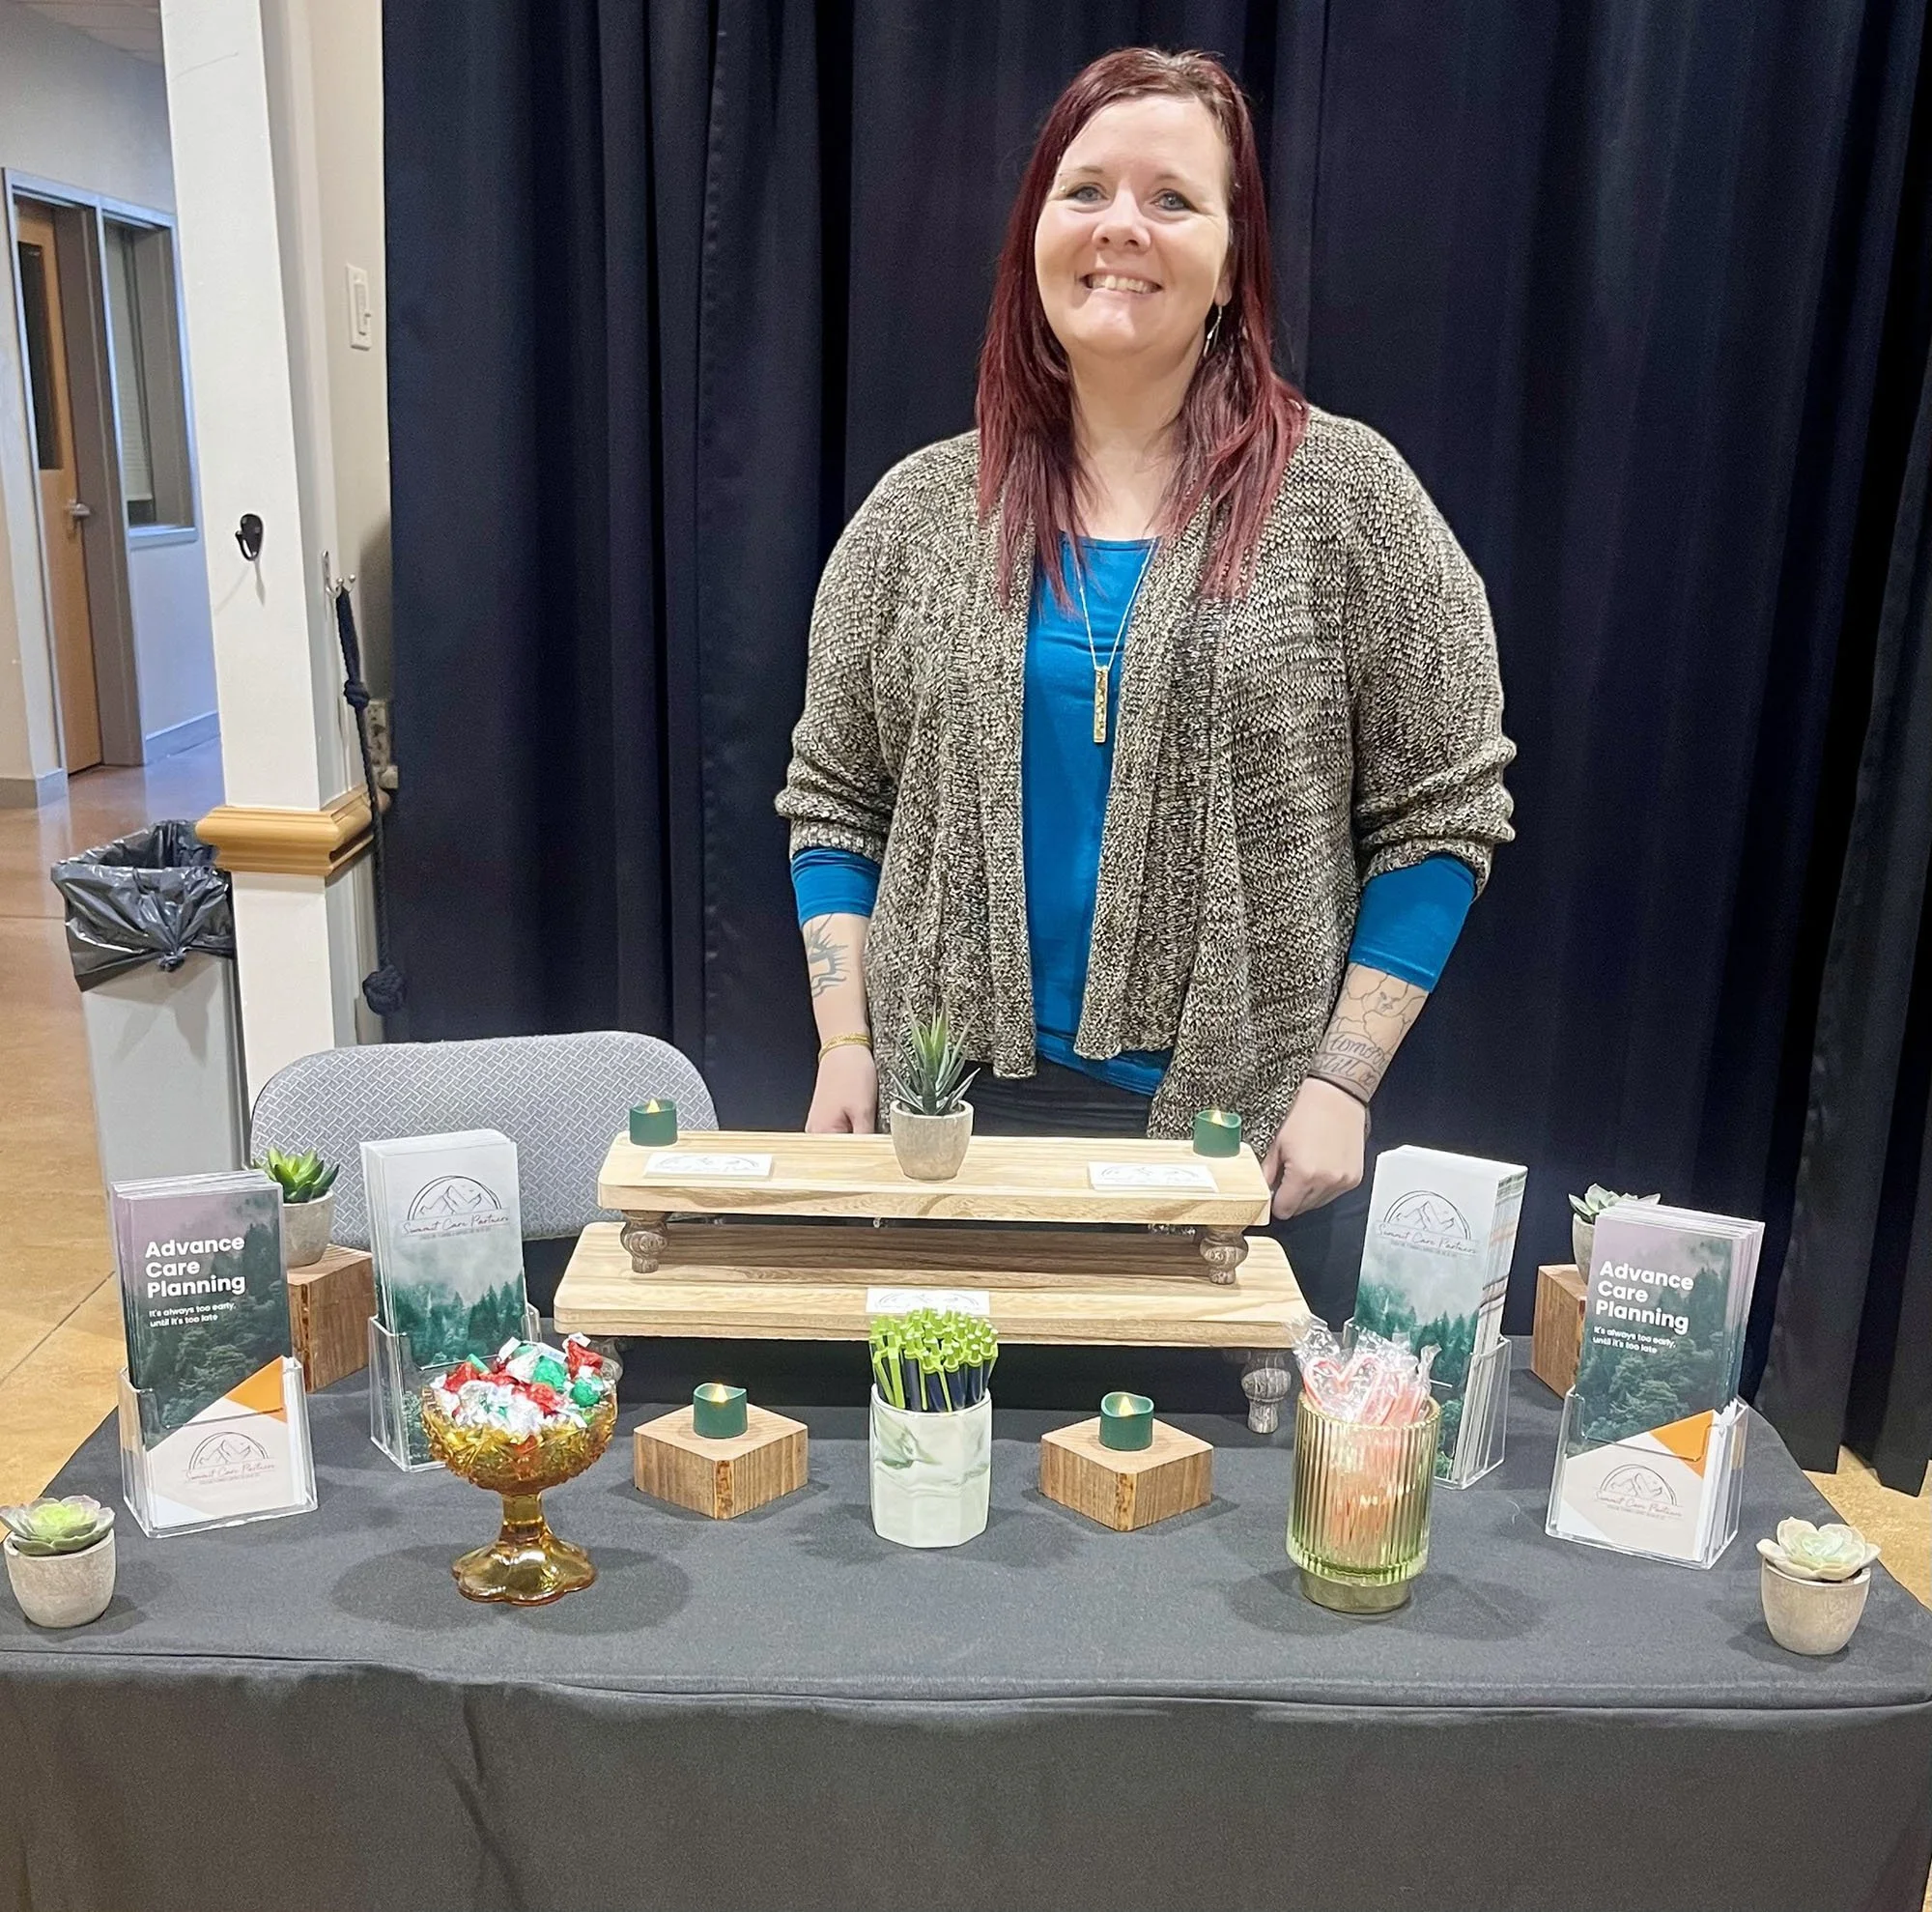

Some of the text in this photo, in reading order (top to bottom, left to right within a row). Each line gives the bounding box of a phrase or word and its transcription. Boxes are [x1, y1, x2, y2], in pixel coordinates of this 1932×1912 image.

[145, 1237, 245, 1259] Advance
[145, 1261, 201, 1278] Care
[1599, 1260, 1694, 1291] Advance
[147, 1274, 245, 1298] Planning
[1597, 1280, 1649, 1303] Care
[149, 1309, 161, 1318] It's
[162, 1306, 195, 1317] always
[196, 1303, 212, 1313] too
[150, 1313, 218, 1327] until it's too late
[1595, 1299, 1690, 1336] Planning
[1593, 1326, 1605, 1334] It's
[1606, 1328, 1636, 1341] always
[1637, 1333, 1652, 1343] too
[1592, 1336, 1658, 1354] until it's too late
